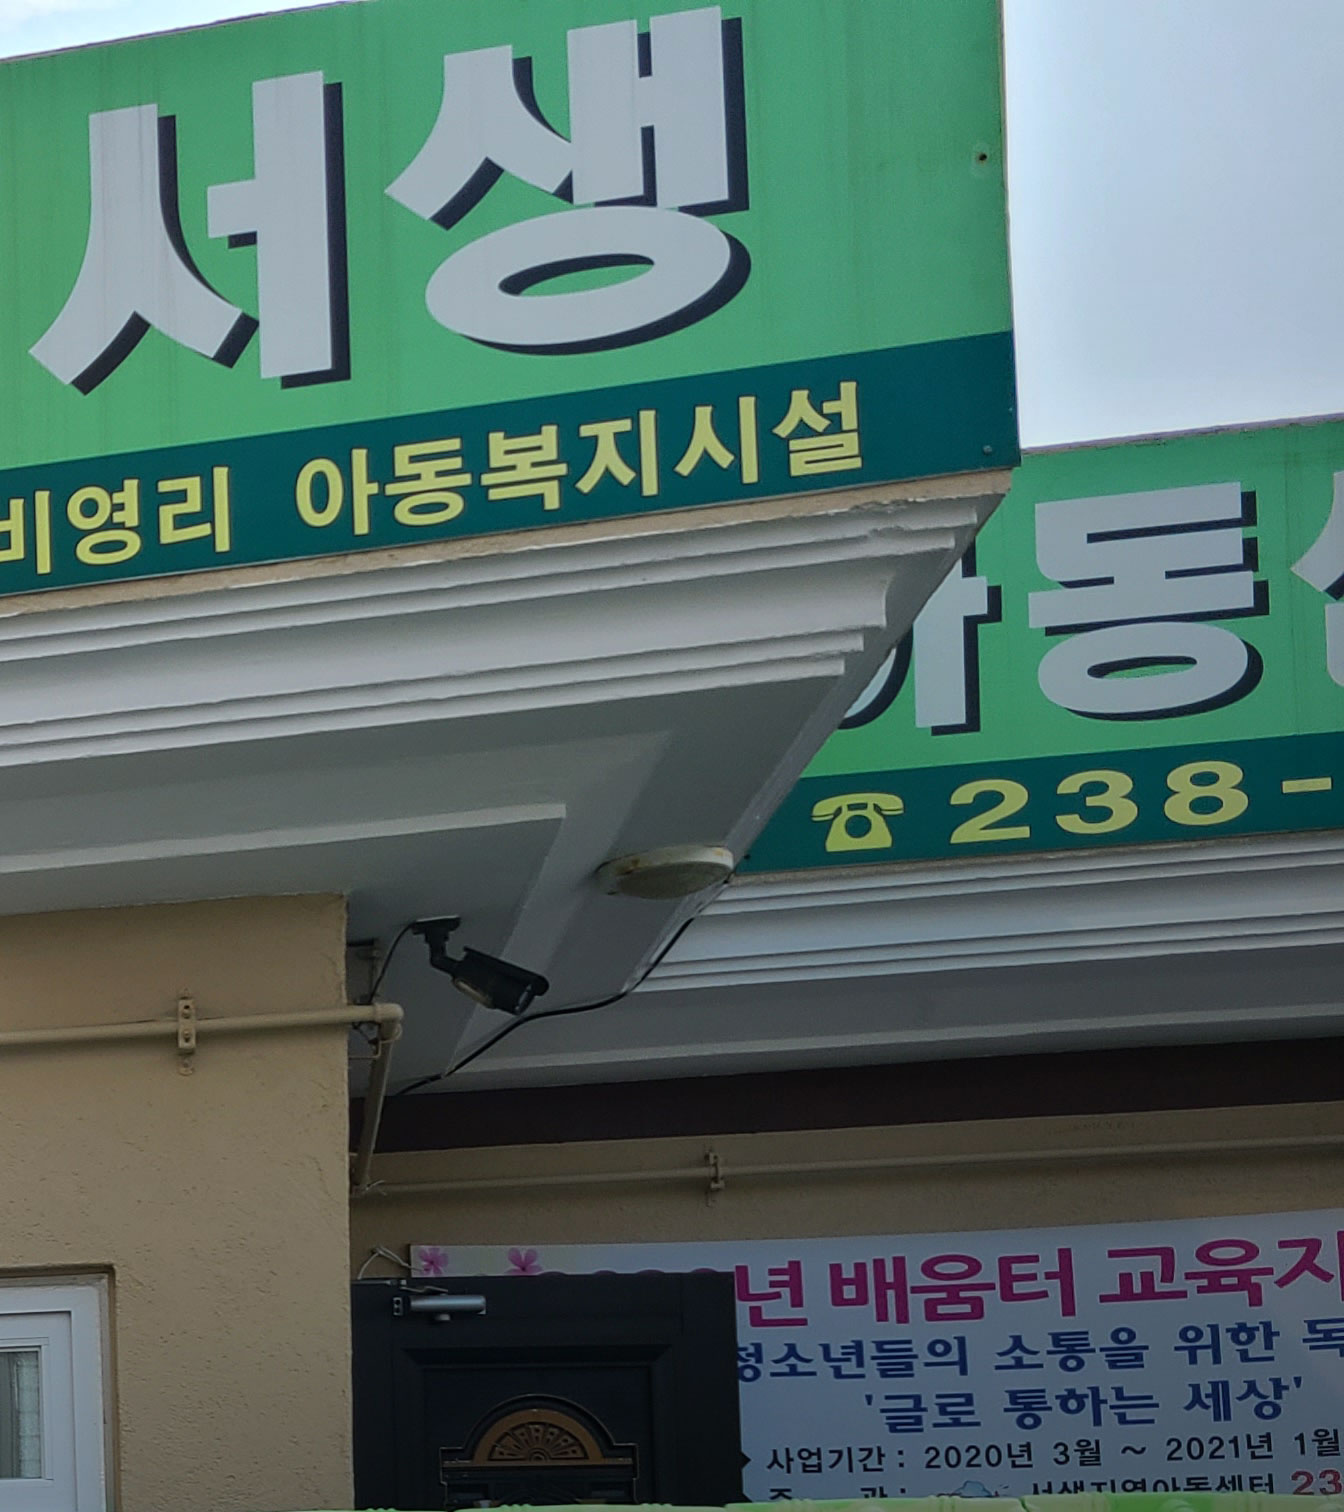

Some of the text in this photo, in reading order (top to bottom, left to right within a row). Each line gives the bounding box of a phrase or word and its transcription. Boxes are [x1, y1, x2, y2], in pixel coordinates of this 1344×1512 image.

[28, 8, 748, 395] 서생
[294, 382, 865, 538] 아동복지시설
[829, 1247, 1076, 1324] 배움터
[995, 1327, 1149, 1372] 소통을
[1174, 1320, 1280, 1365] 위한
[1004, 1386, 1159, 1430] 통하는
[924, 1441, 1033, 1469] 2020년
[1053, 1439, 1102, 1467] 3월
[1166, 1432, 1273, 1461] 2021년
[1294, 1428, 1341, 1458] 1월
